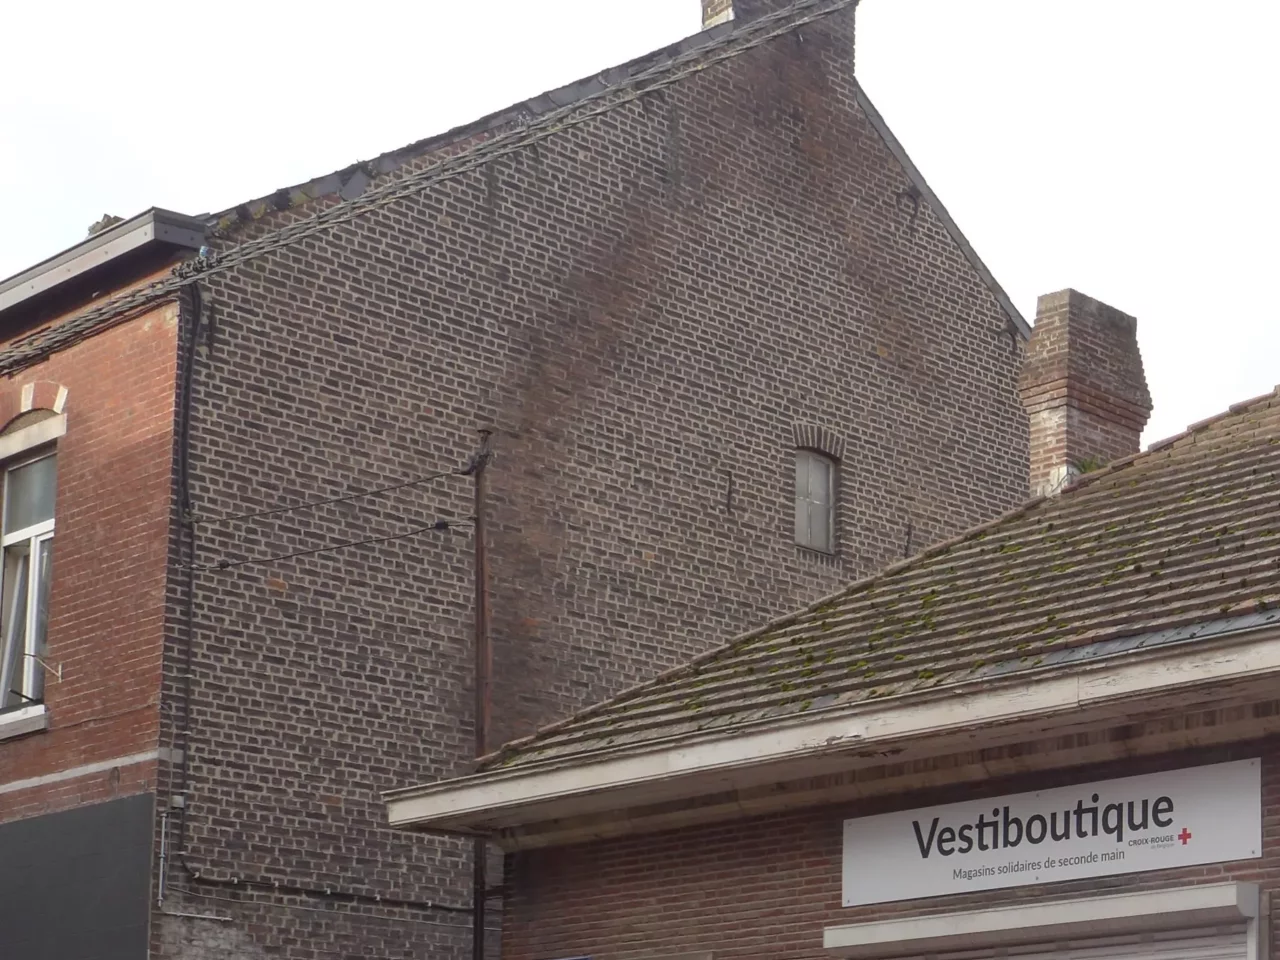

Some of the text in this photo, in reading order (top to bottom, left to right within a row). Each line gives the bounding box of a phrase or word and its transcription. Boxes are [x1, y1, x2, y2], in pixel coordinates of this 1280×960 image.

[912, 792, 1175, 859] Vestiboutique
[1128, 834, 1175, 847] CROIX-ROUGE
[952, 848, 1125, 882] Magasins solidaires de seconde main
